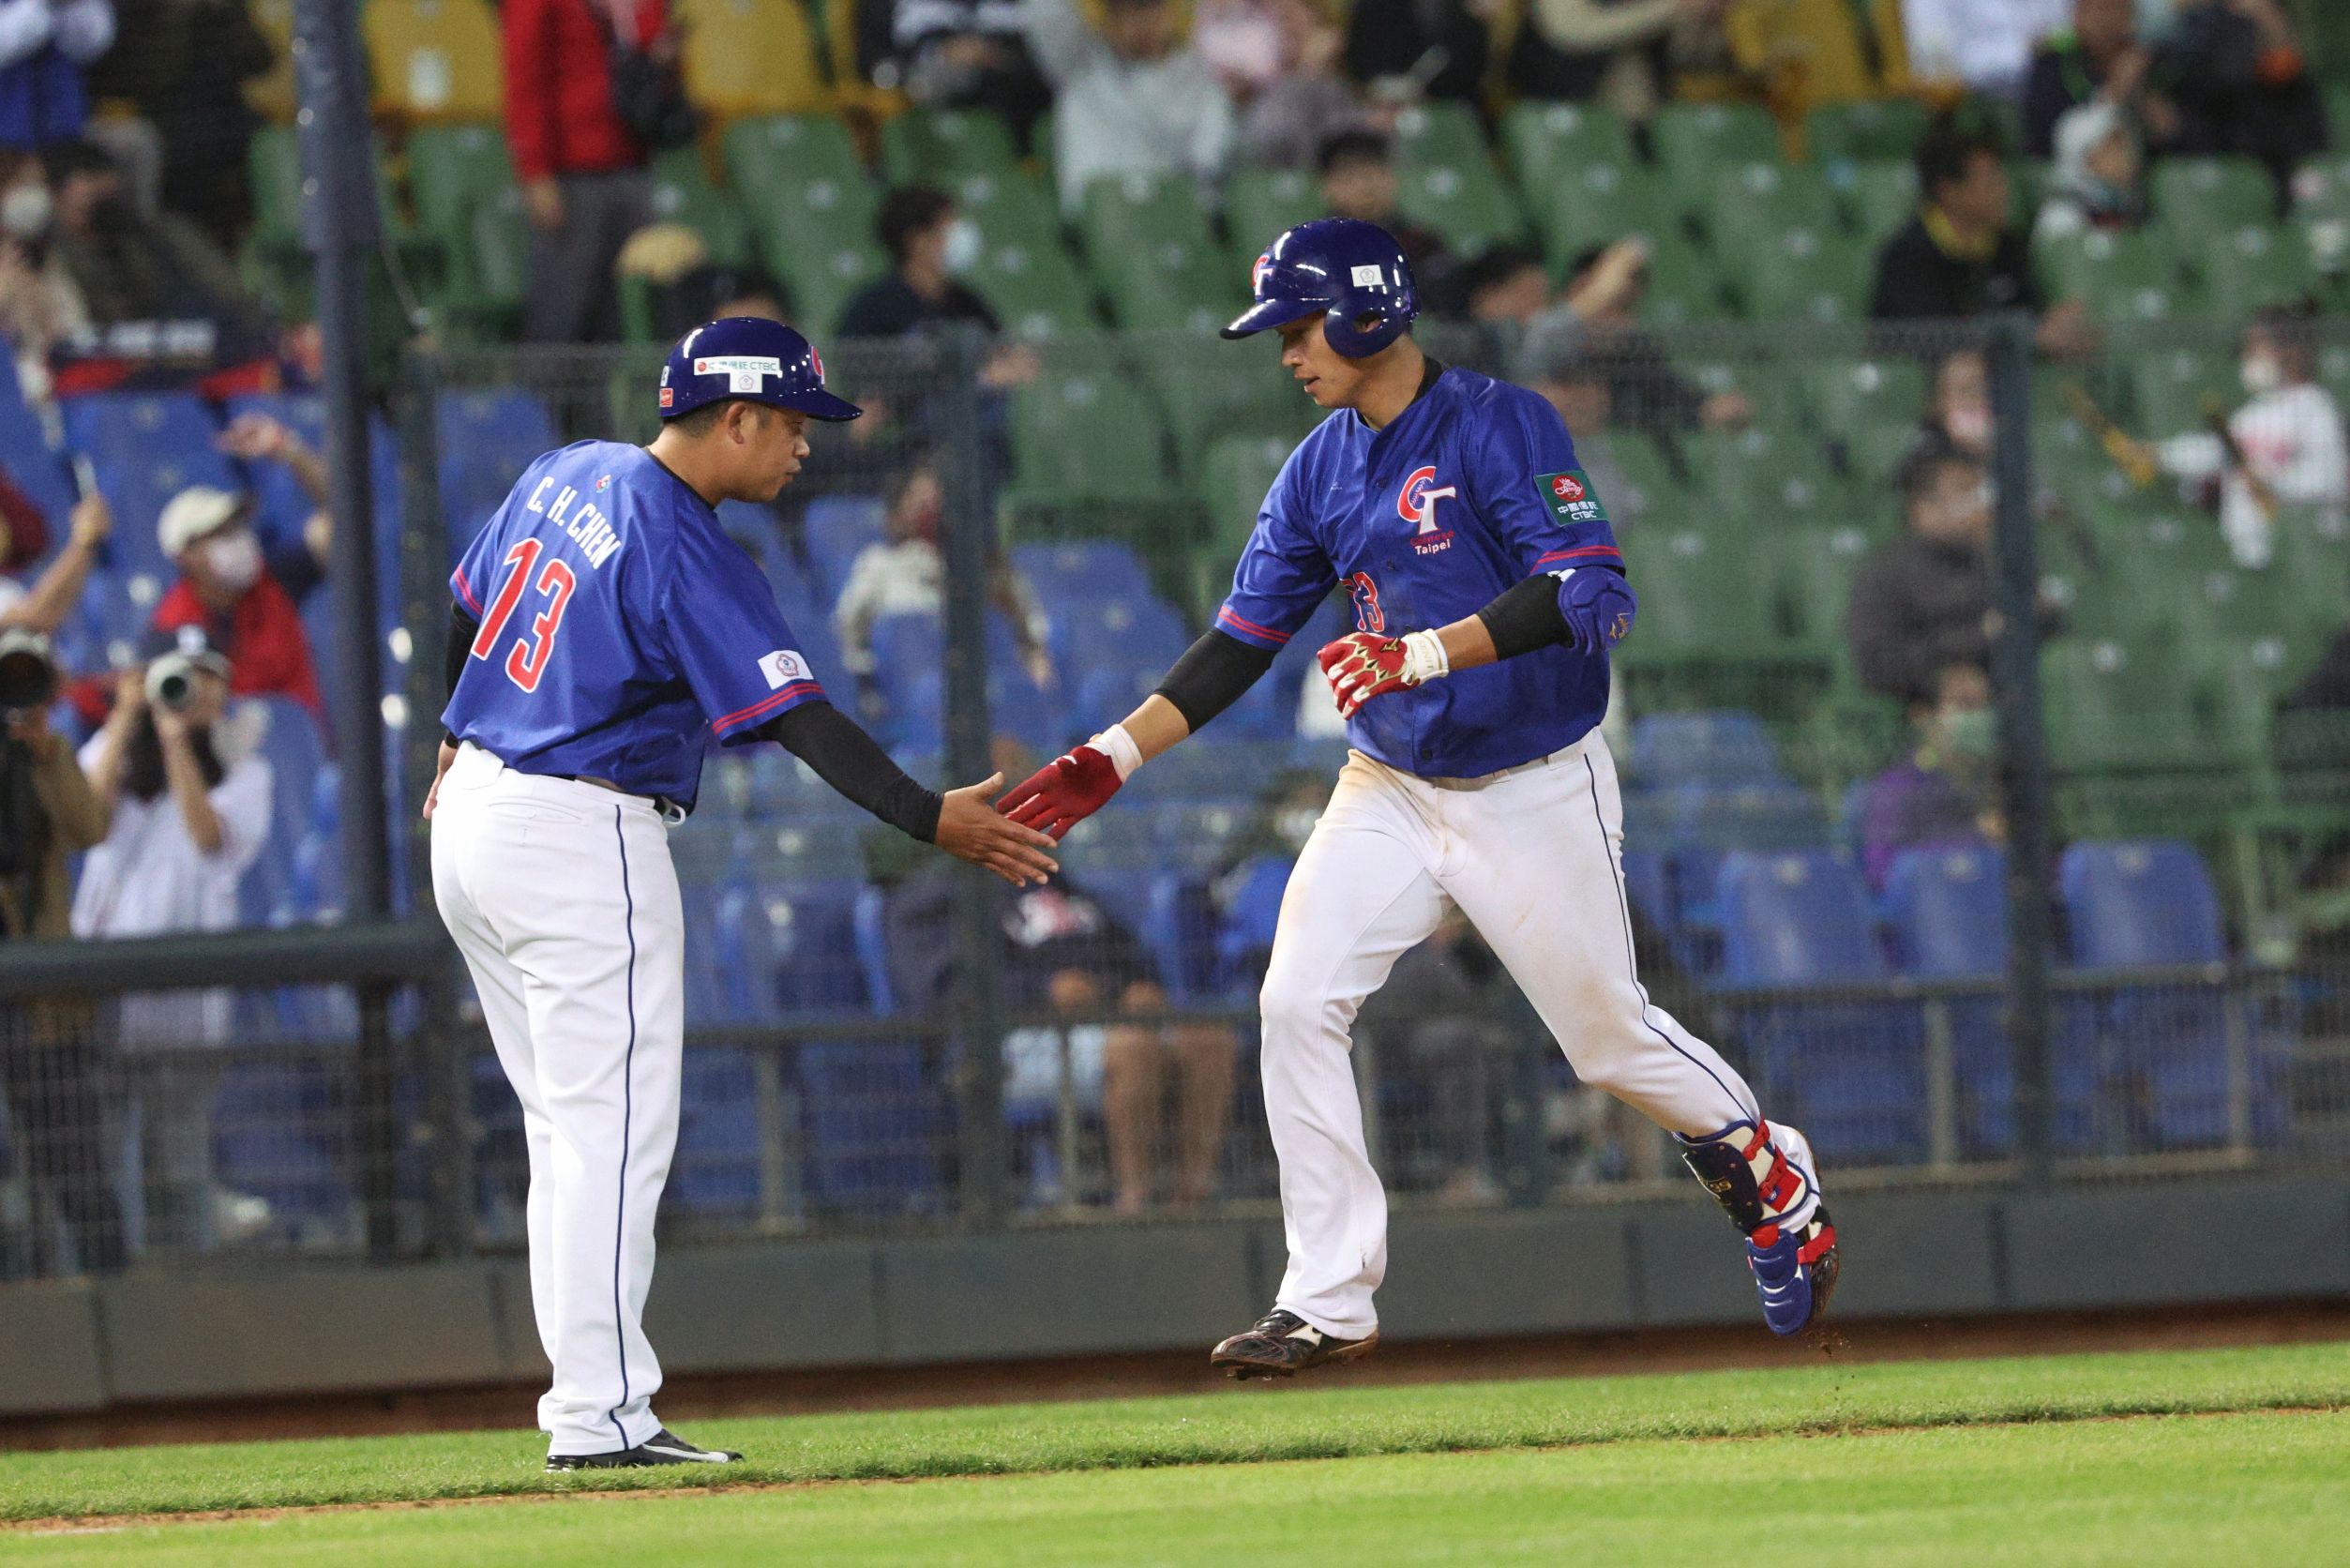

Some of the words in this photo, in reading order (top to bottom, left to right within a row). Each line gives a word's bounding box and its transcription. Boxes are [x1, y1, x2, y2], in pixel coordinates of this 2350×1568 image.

[749, 361, 777, 371] CTBC
[527, 475, 555, 514] C.
[546, 485, 579, 527] H.
[565, 503, 622, 570] CHEN
[1571, 510, 1597, 520] CTBC
[1414, 538, 1451, 555] Taipei
[470, 536, 577, 694] 13
